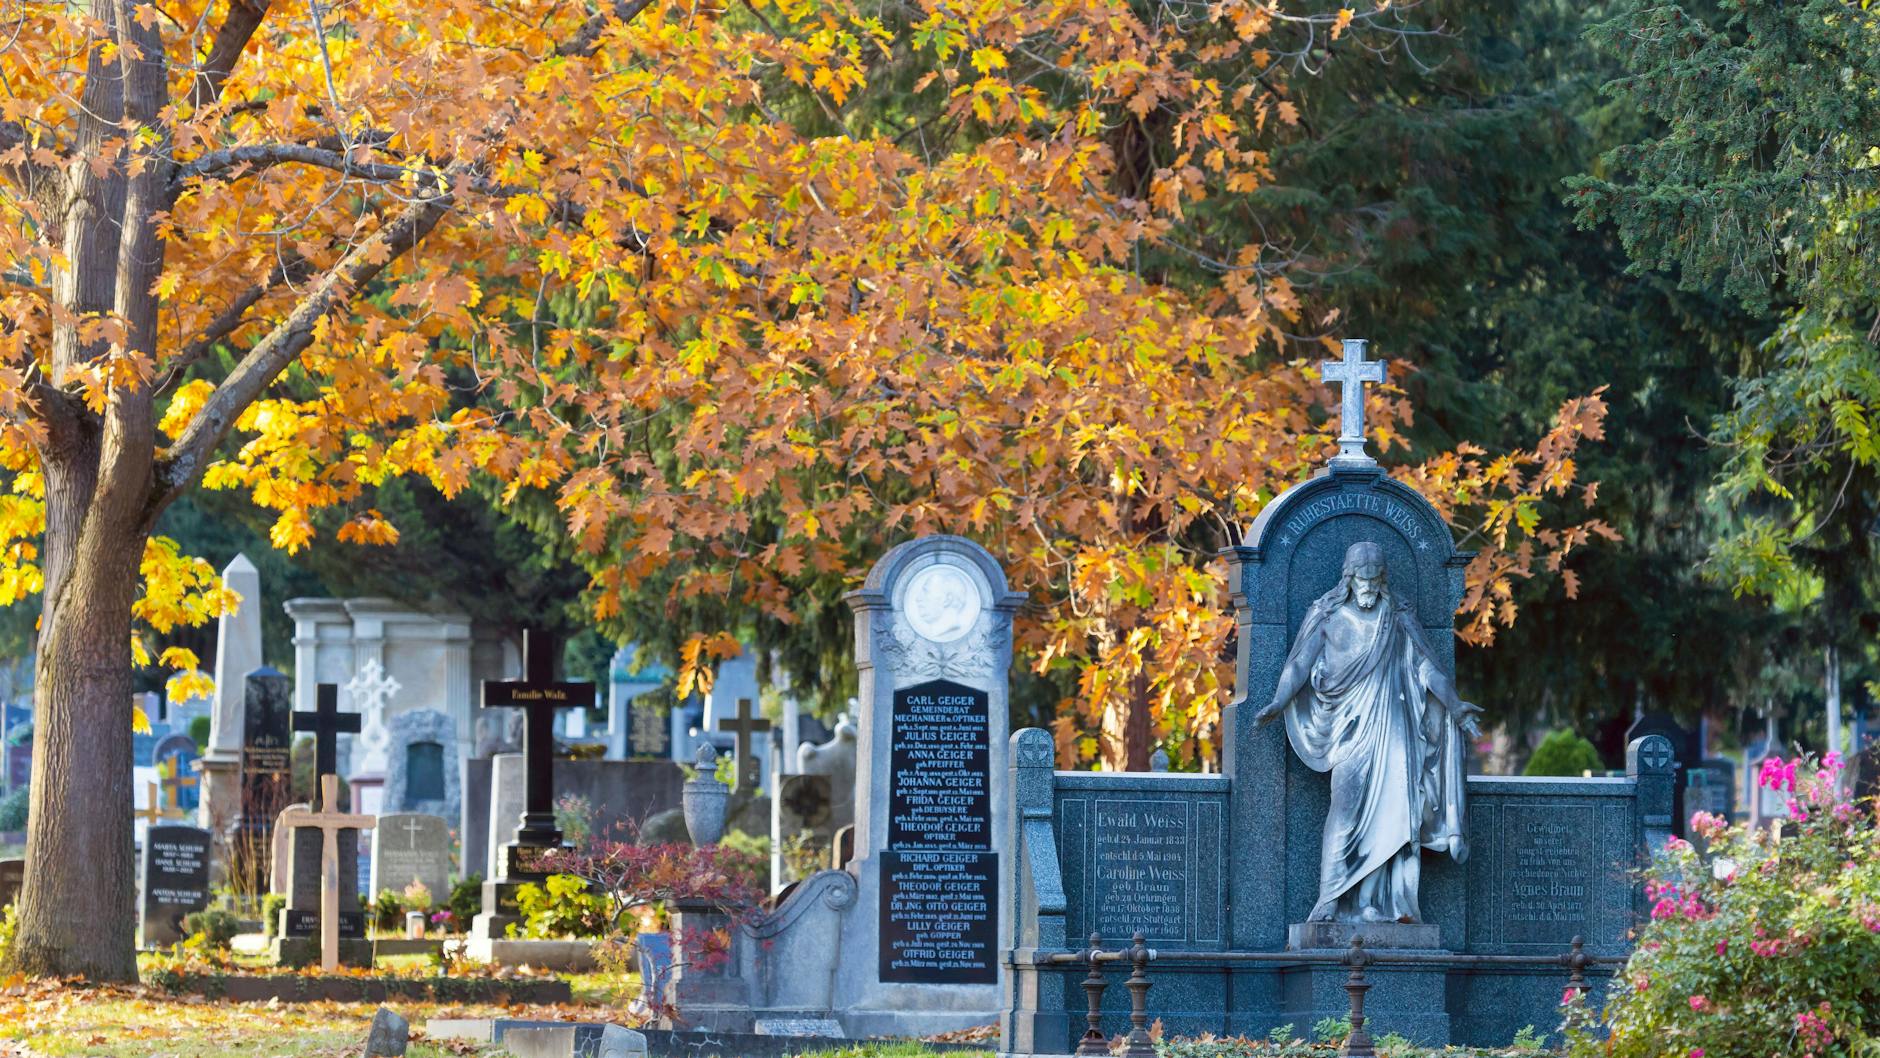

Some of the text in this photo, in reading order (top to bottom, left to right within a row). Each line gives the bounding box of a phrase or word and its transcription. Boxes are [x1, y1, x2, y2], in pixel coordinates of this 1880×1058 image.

[1288, 493, 1421, 538] RUHESTAETTE WEISS
[511, 688, 543, 700] Familie
[906, 696, 975, 706] CARL GEIGER
[910, 706, 970, 714] GEMEINDERAT
[894, 714, 945, 723] MECHANIKER
[952, 715, 986, 723] OPTIKER
[904, 732, 977, 741] JULIUS GEIGER
[908, 750, 974, 760] ANNA GEIGER
[928, 760, 965, 769] PFEIFFER
[898, 777, 983, 787] JOHANNA GEIGER
[906, 796, 974, 806] FRIDA GEIGER
[1098, 812, 1184, 829] Ewald Weiss
[900, 822, 981, 833] THEODOR GEIGER
[924, 832, 956, 841] OPTIKER
[1133, 834, 1164, 845] Januar
[1166, 835, 1185, 845] 1833
[900, 853, 979, 863] RICHARD GEIGER
[1146, 851, 1161, 861] Mai
[933, 864, 966, 872] OPTIKER
[1097, 865, 1185, 881] Caroline Weiss
[899, 881, 980, 892] THEODOR GEIGER
[1112, 880, 1169, 896] geb. Braun
[1511, 880, 1584, 899] Agnes Braun
[1122, 895, 1132, 903] zu
[1133, 893, 1177, 906] Oehringen
[926, 902, 949, 911] OTTO
[951, 902, 987, 912] GEIGER
[1101, 903, 1116, 912] den
[1127, 904, 1160, 913] Oktober
[1548, 901, 1568, 912] April
[1143, 915, 1181, 926] Stuttgart
[907, 921, 971, 931] LILLY GEIGER
[1101, 925, 1117, 933] den
[1126, 924, 1160, 934] Oktober
[903, 950, 975, 960] OTFRID GEIGER
